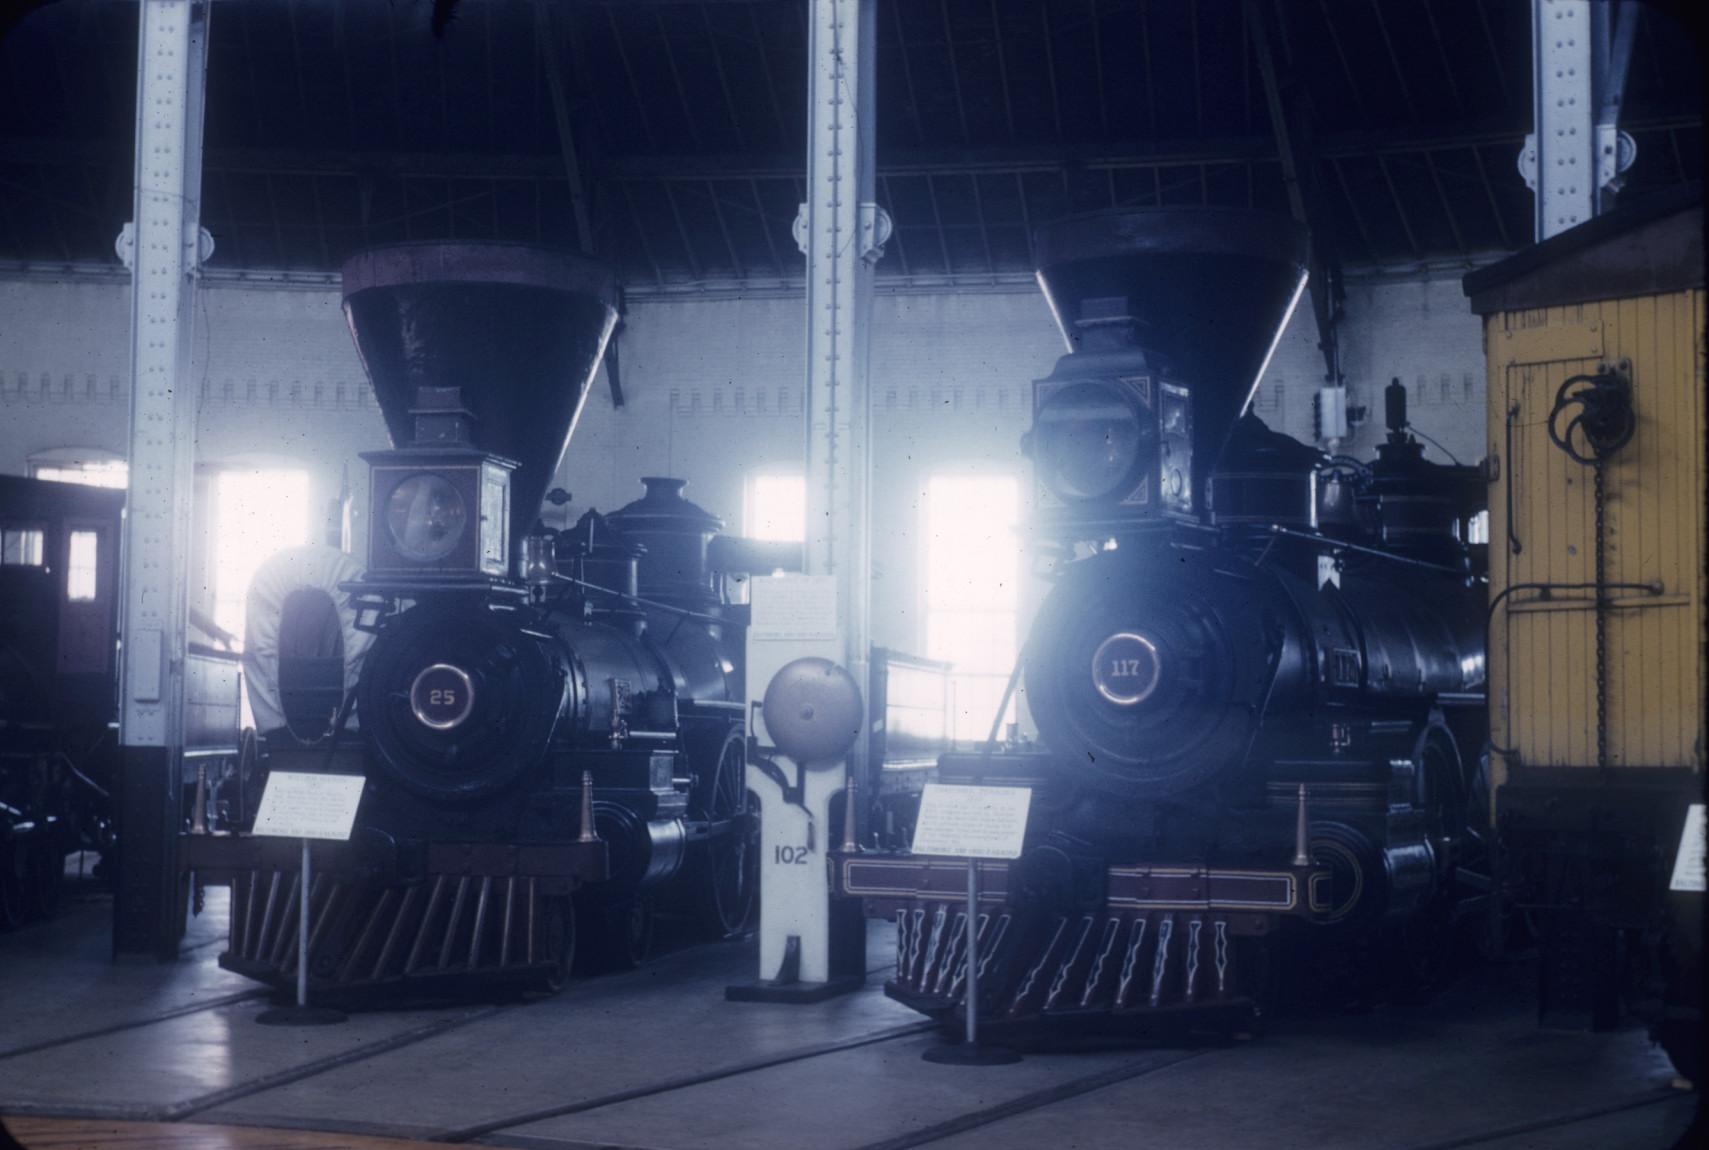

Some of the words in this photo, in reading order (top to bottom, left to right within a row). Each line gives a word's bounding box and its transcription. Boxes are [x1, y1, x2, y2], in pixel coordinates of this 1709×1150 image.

[1111, 660, 1140, 677] 117
[429, 689, 455, 705] 25
[775, 845, 808, 865] 102
